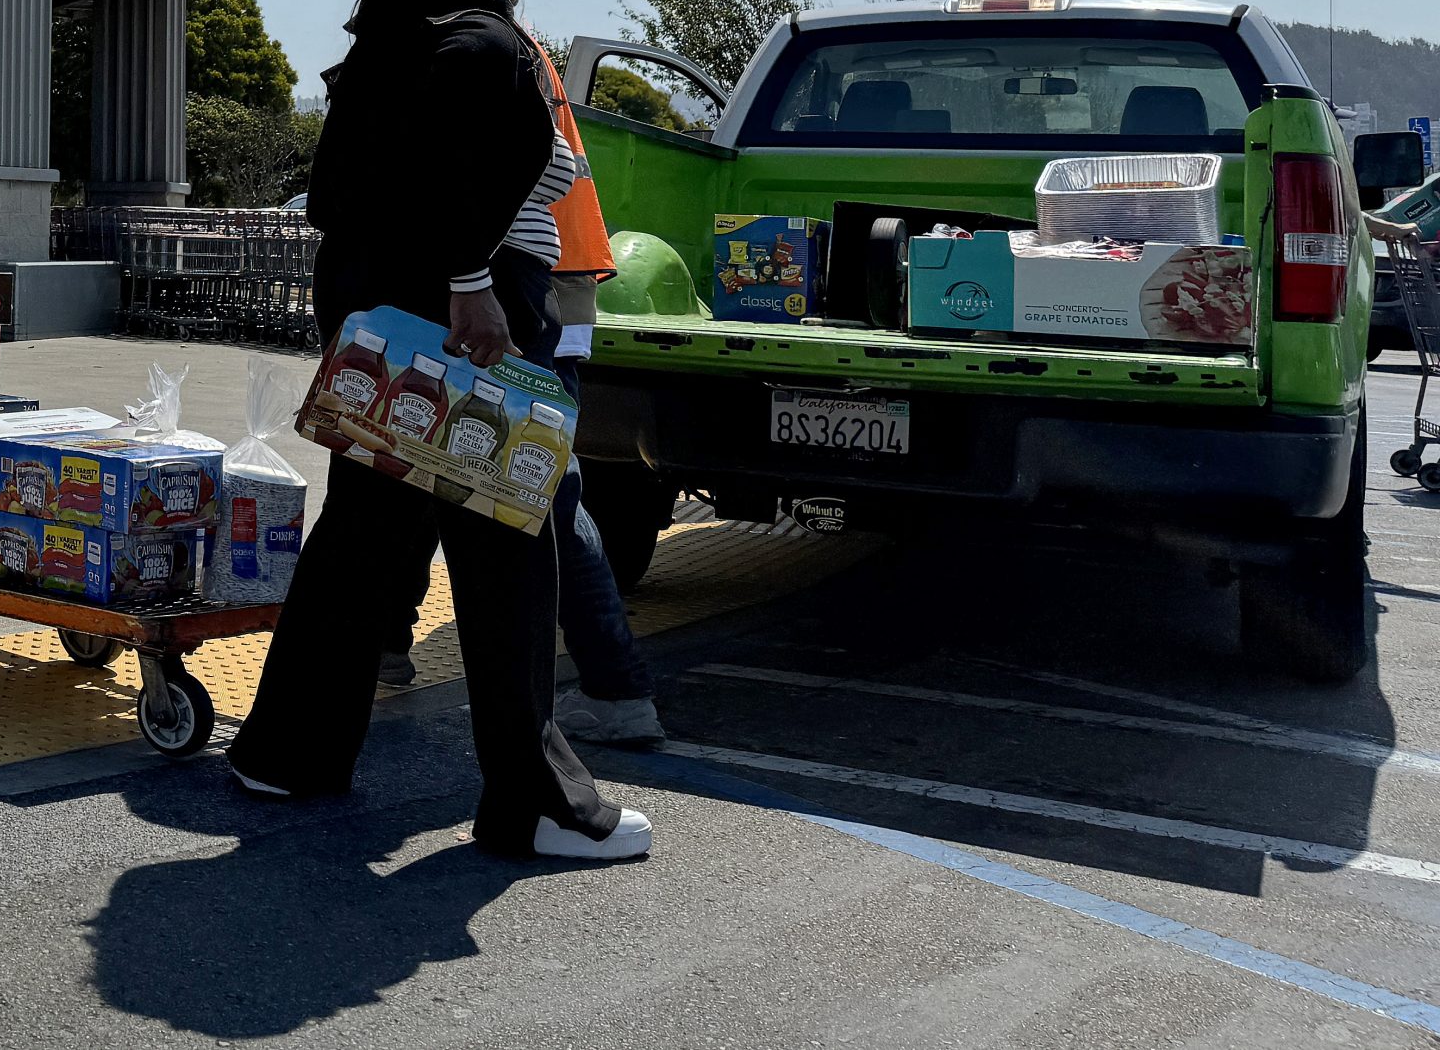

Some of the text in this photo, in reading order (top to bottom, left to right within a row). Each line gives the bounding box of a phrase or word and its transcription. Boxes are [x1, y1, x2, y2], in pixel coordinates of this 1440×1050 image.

[740, 295, 802, 308] classic 54
[941, 298, 994, 308] windset
[1024, 313, 1062, 323] GRAPE
[1066, 315, 1129, 327] TOMATOES
[346, 374, 369, 388] HEINZ
[495, 363, 533, 383] VARIETY
[534, 379, 560, 392] PACK
[405, 398, 428, 411] HEINZ
[798, 398, 880, 414] California
[404, 408, 423, 420] TOMATO
[466, 423, 488, 436] HEINZ
[777, 412, 902, 452] 8S36204
[462, 431, 484, 443] SWEET
[458, 437, 483, 451] RELISH
[525, 448, 547, 461] HEINZ
[63, 465, 72, 474] 40
[468, 460, 495, 476] HEINZ
[521, 459, 542, 471] YELLOW
[514, 464, 543, 480] MUSTARD
[24, 485, 41, 496] 100%
[168, 489, 192, 499] 100%
[20, 493, 43, 509] JUICE
[163, 498, 194, 511] JUICE
[802, 504, 833, 517] Walnut
[816, 520, 844, 531] Ford
[45, 534, 81, 545] 40 VARIETY
[63, 542, 77, 551] PACK
[5, 549, 24, 559] 100%
[2, 556, 24, 572] JUICE
[144, 557, 167, 567] 100%
[140, 567, 169, 580] JUICE
